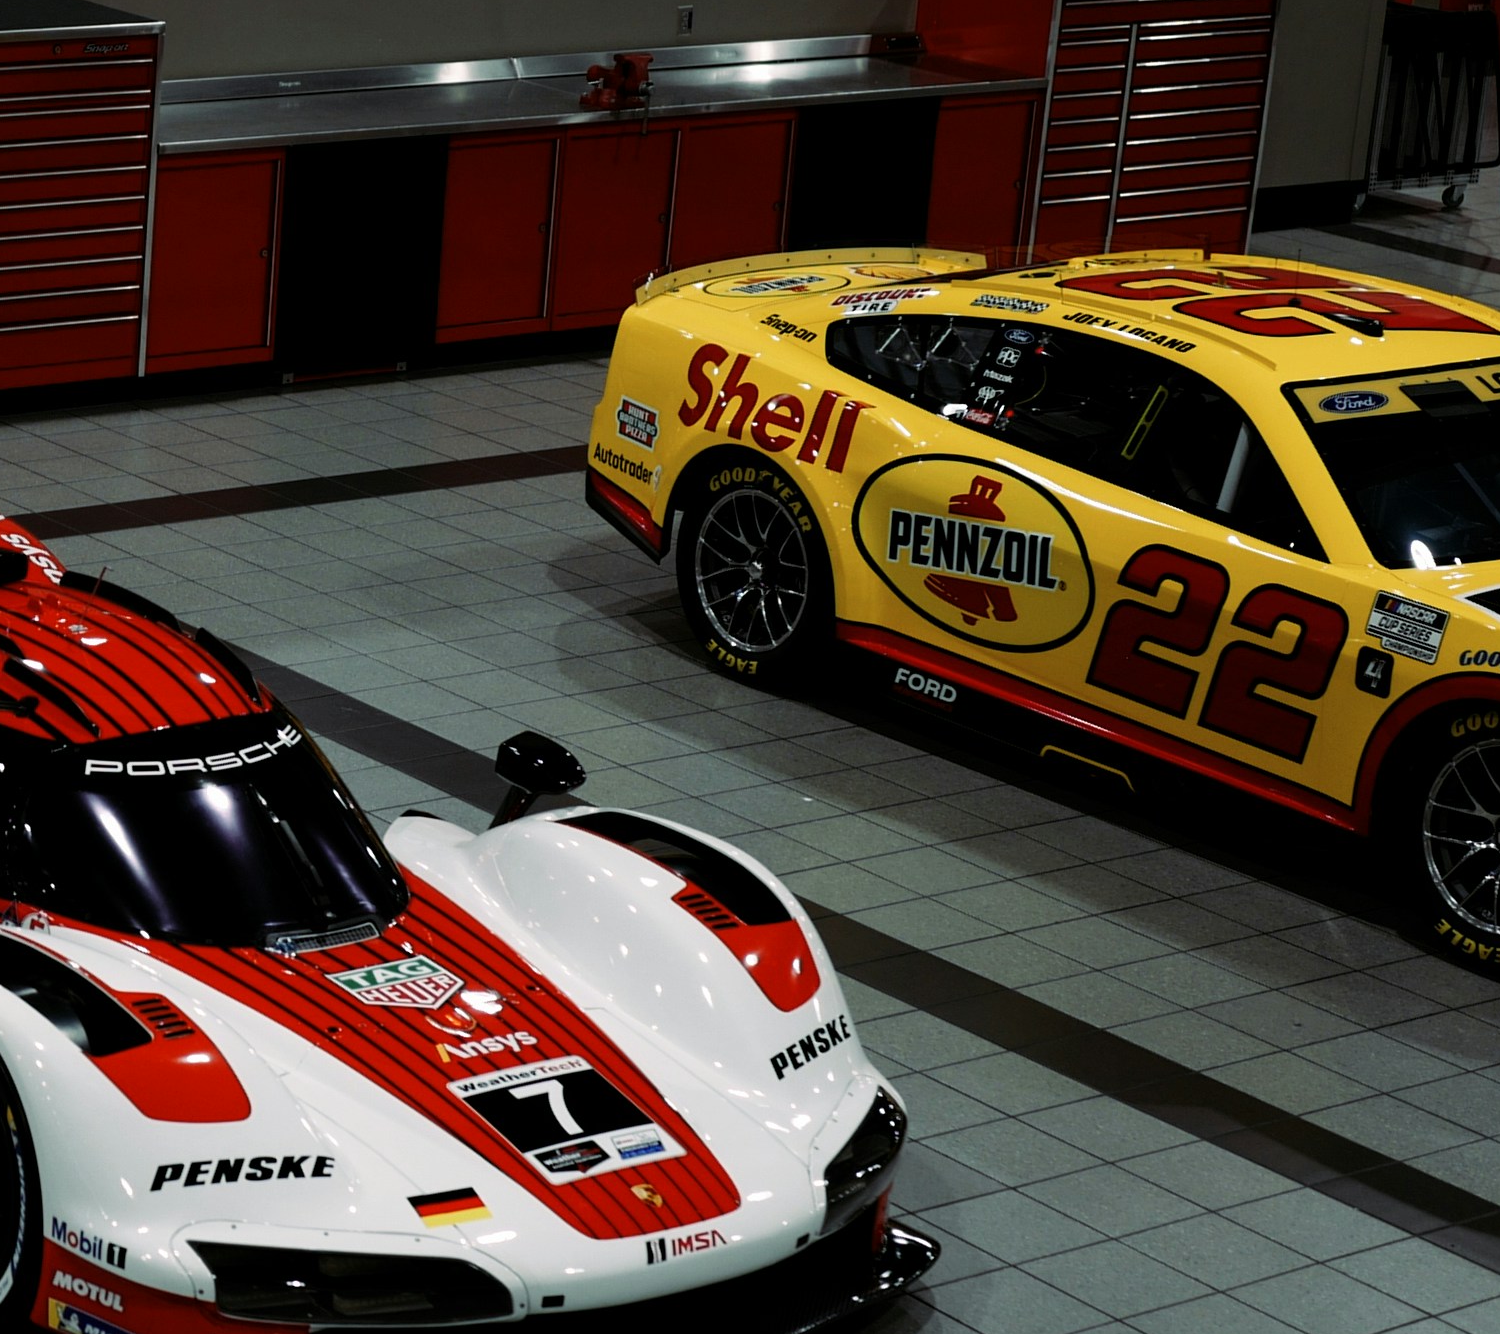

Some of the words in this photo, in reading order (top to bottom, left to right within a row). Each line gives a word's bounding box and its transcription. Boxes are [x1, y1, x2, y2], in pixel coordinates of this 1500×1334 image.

[83, 43, 130, 56] Snap-on
[831, 287, 935, 306] DISCOUNT
[850, 301, 892, 314] TIRE
[761, 313, 818, 344] Snap-on
[1063, 312, 1118, 331] JOEY
[1118, 321, 1197, 355] LOGANO
[982, 367, 1015, 385] Mazak
[627, 403, 651, 422] HUNT
[677, 341, 875, 474] Shell
[1333, 392, 1389, 412] Ford
[618, 411, 657, 437] BROTHERS
[624, 422, 650, 443] PIZZA
[592, 441, 655, 486] Autotrader
[708, 466, 813, 534] GOODYEAR
[887, 508, 1060, 592] PENNZOIL
[1378, 614, 1400, 634] CUP
[1399, 619, 1434, 643] SERIES
[1395, 601, 1437, 625] NASCAR
[704, 637, 760, 676] EAGLE
[1085, 543, 1349, 765] 22
[894, 667, 958, 706] FORD
[83, 722, 304, 778] PORSCHE
[336, 957, 434, 990] TAG
[361, 973, 461, 1007] HEUER
[436, 1029, 540, 1063] Ansys
[770, 1015, 851, 1080] PENSKE
[454, 1057, 584, 1094] WeatherTech
[507, 1078, 586, 1136] 7
[150, 1155, 335, 1192] PENSKE
[51, 1216, 102, 1261] Mobil
[671, 1230, 727, 1258] IMSA
[51, 1269, 125, 1312] MOTUL
